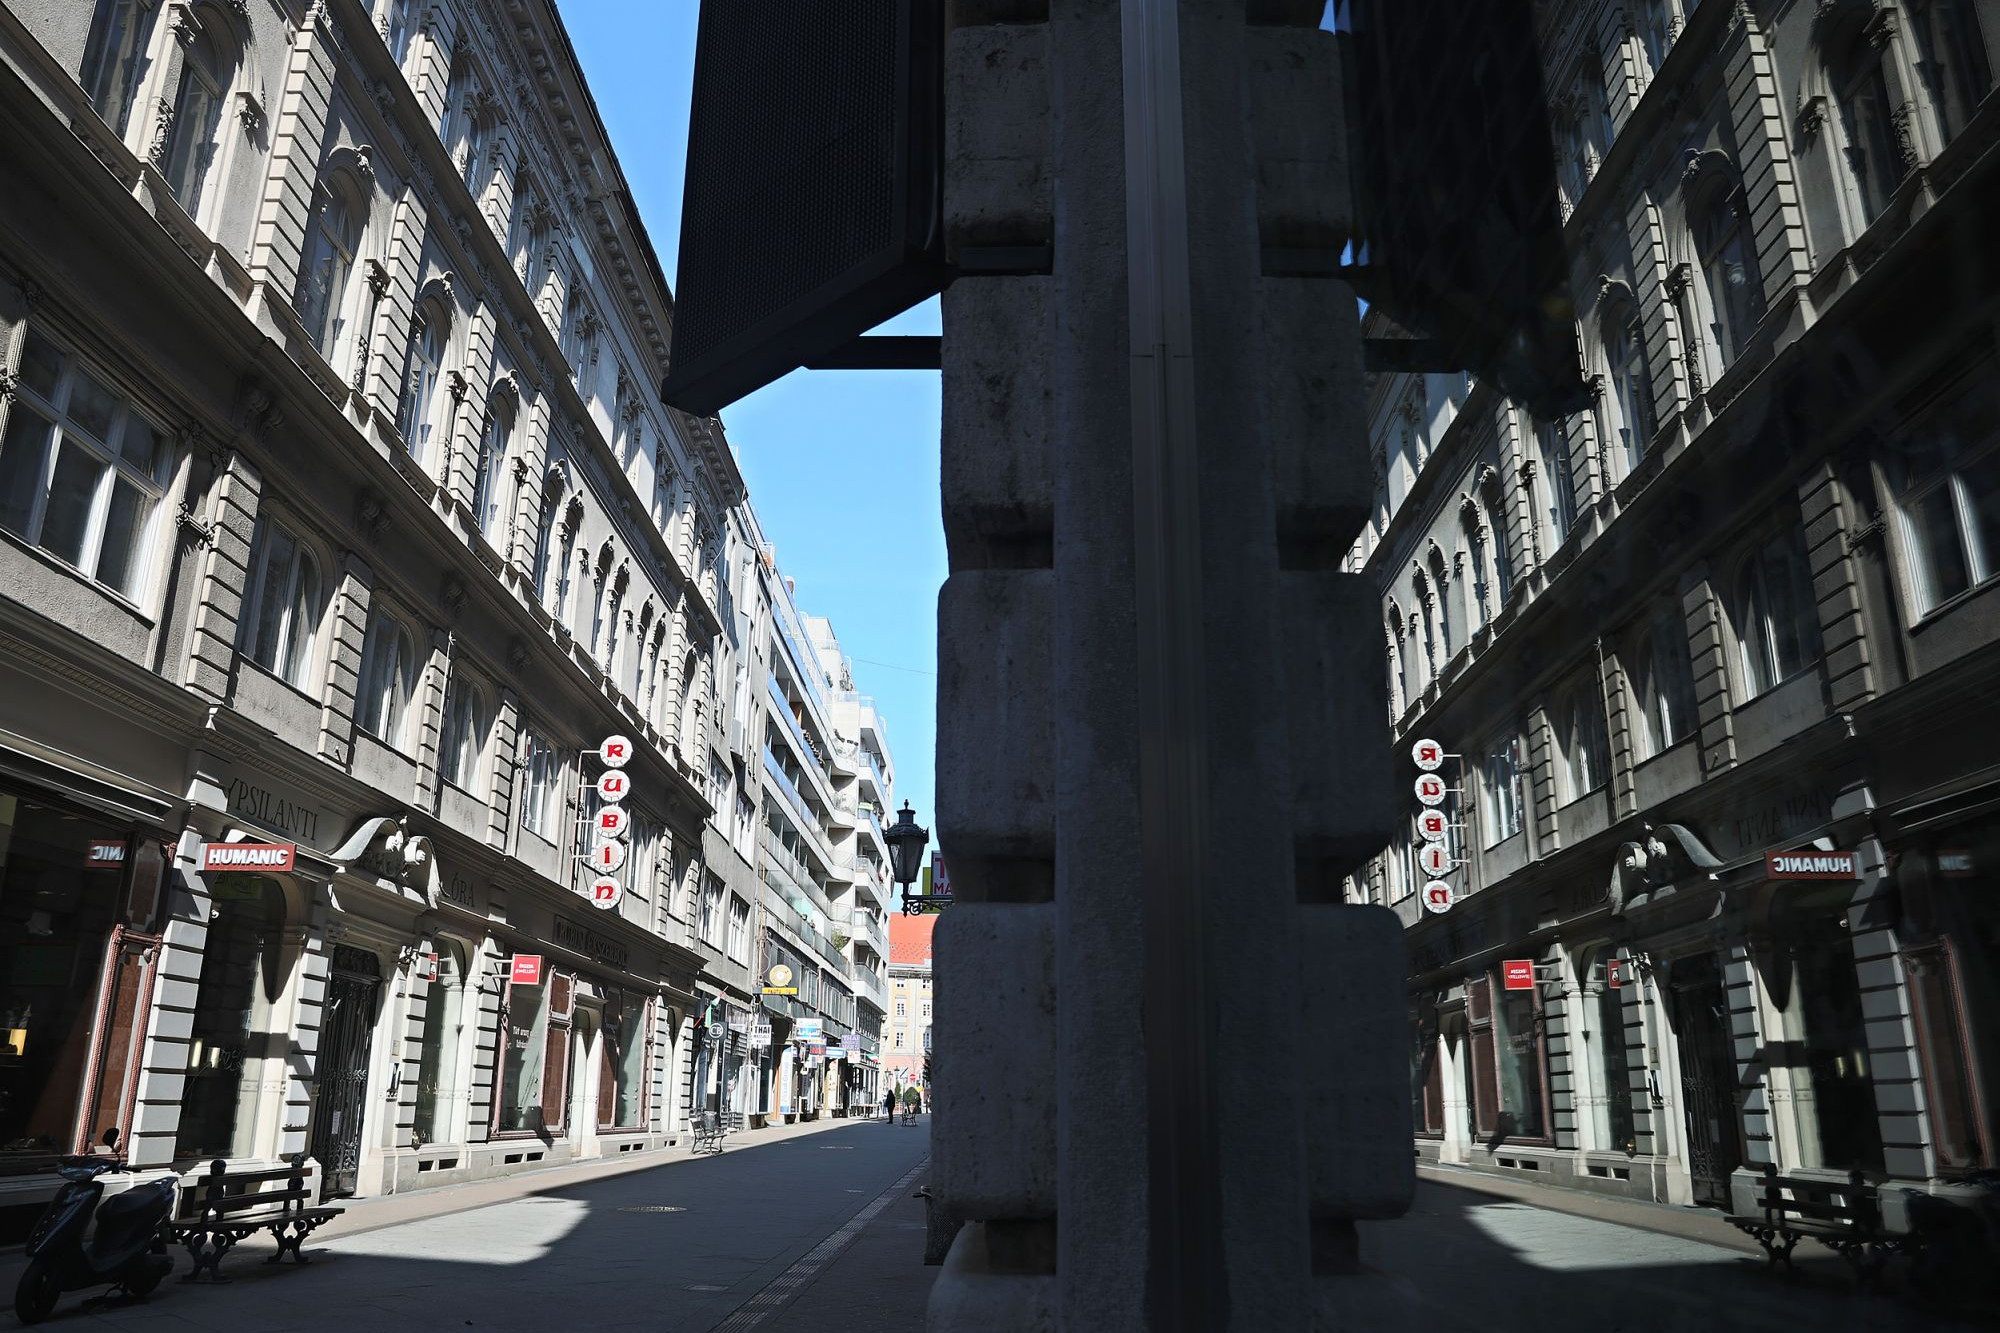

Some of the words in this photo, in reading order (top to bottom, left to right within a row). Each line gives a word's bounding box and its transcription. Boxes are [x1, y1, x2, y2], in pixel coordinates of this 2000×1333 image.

[227, 777, 318, 840] YPSILANTI
[208, 848, 288, 866] HUMANIC
[754, 1026, 771, 1034] THAI
